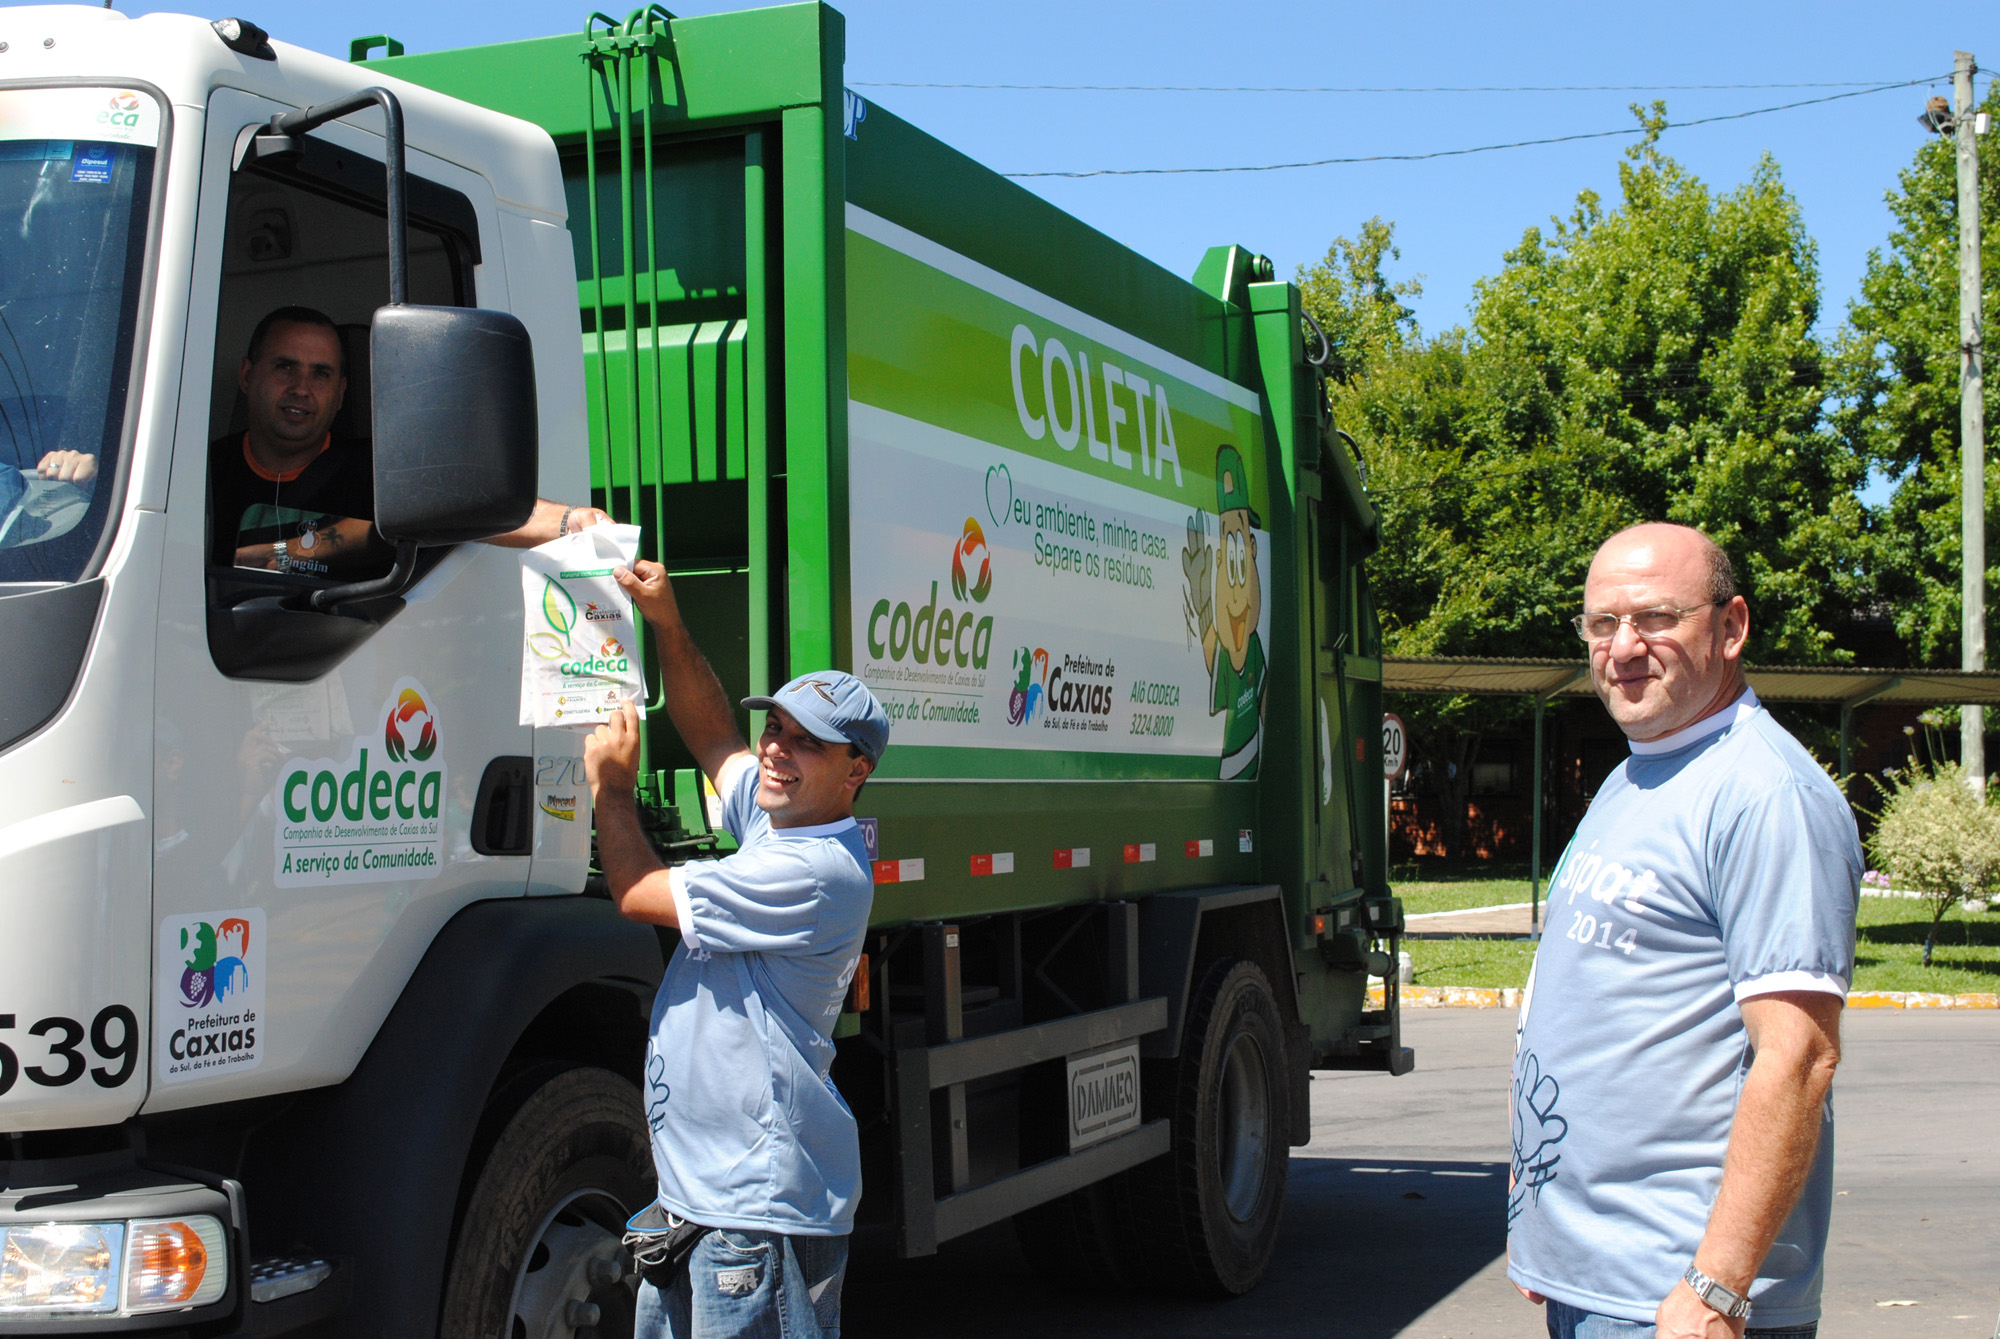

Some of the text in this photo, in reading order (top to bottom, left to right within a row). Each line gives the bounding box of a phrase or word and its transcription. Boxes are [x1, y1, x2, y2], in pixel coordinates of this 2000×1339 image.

[81, 158, 108, 166] Dipesul
[1010, 324, 1183, 488] COLETA
[1014, 498, 1170, 560] eu ambiente, minha casa.
[282, 555, 329, 574] Pingüim
[1034, 532, 1155, 590] Separe os resíduos.
[585, 611, 622, 620] Caxias
[867, 580, 994, 670] codeca
[560, 654, 628, 676] codeca
[864, 663, 896, 683] Companhia
[896, 666, 903, 681] de
[904, 667, 947, 684] Desenvolvimento
[947, 672, 954, 685] de
[954, 672, 971, 687] Caxias
[1064, 653, 1115, 677] Prefeitura de
[1047, 666, 1113, 716] Caxias
[1130, 680, 1180, 707] Alô CODECA
[881, 697, 980, 726] rviço da Comunidade.
[1044, 716, 1051, 728] do
[1051, 717, 1060, 730] Sul,
[1062, 718, 1069, 730] da
[1069, 718, 1076, 730] Fé
[1080, 719, 1087, 731] do
[1088, 720, 1108, 732] Trabalho
[1130, 713, 1175, 737] 3224.8000
[1383, 727, 1400, 755] 20
[535, 756, 586, 786] 270
[283, 748, 442, 823] codeca
[283, 822, 438, 842] Companhia de Desenvolvimento de Caxias do Sul
[282, 847, 437, 878] A serviço da Comunidade.
[1560, 839, 1661, 914] sipat
[1566, 910, 1638, 955] 2014
[188, 1009, 256, 1031] Prefeitura de
[169, 1027, 256, 1061] Caxias
[169, 1064, 179, 1074] do
[180, 1062, 192, 1072] Sul,
[193, 1061, 202, 1070] da
[203, 1059, 211, 1068] Fé
[218, 1057, 226, 1066] do
[227, 1053, 255, 1064] Trabalho
[1077, 1070, 1134, 1120] DAMAEQ
